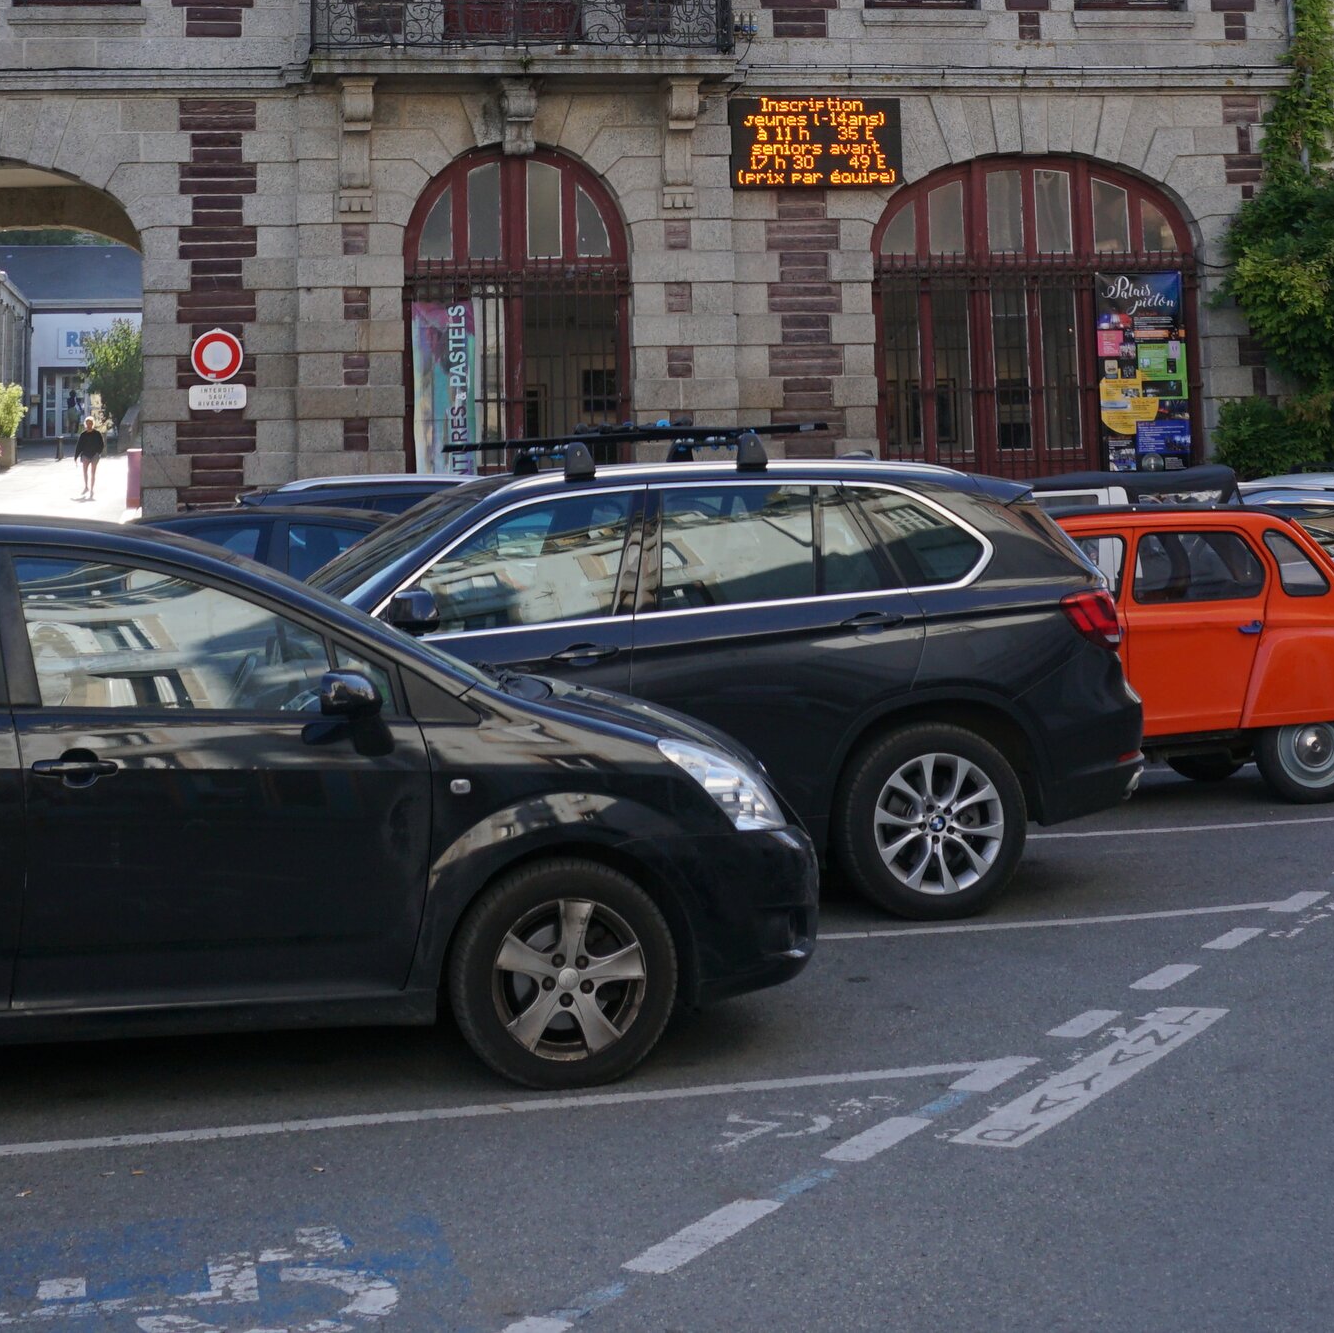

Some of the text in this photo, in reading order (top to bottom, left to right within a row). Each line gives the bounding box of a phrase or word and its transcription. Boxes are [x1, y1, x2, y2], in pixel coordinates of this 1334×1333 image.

[761, 97, 863, 112] Inscription
[814, 112, 885, 126] (-14ans)
[757, 126, 875, 141] à 11 h 35 E
[751, 140, 823, 155] seniors
[750, 154, 887, 170] 17 h 30 49 E
[738, 169, 896, 184] (prix par équipe)
[1101, 275, 1151, 300] Palais
[447, 304, 467, 387] PASTELS
[975, 1009, 1202, 1143] PAYANT
